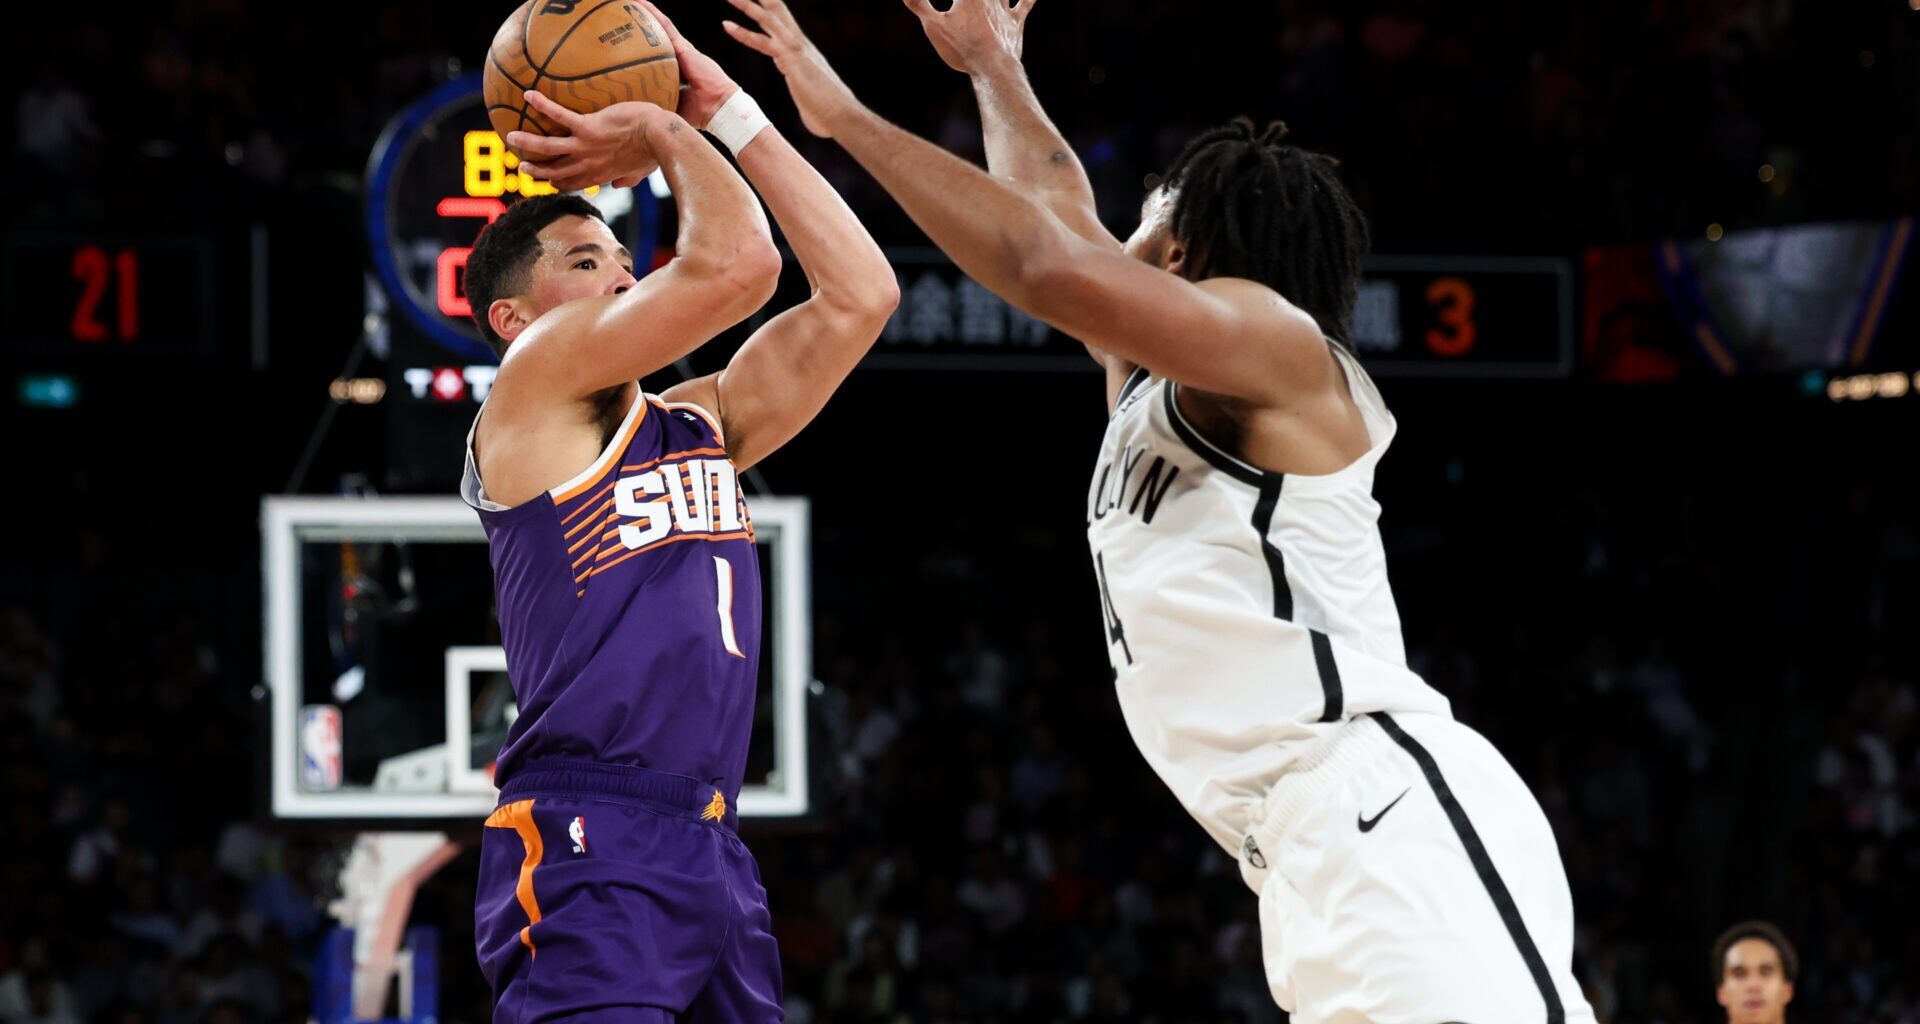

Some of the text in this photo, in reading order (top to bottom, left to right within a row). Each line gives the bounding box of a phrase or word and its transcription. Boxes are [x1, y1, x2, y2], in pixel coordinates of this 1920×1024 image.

[70, 246, 142, 344] 21
[1422, 274, 1478, 360] 3
[614, 458, 748, 550] SUN
[713, 555, 746, 658] 1
